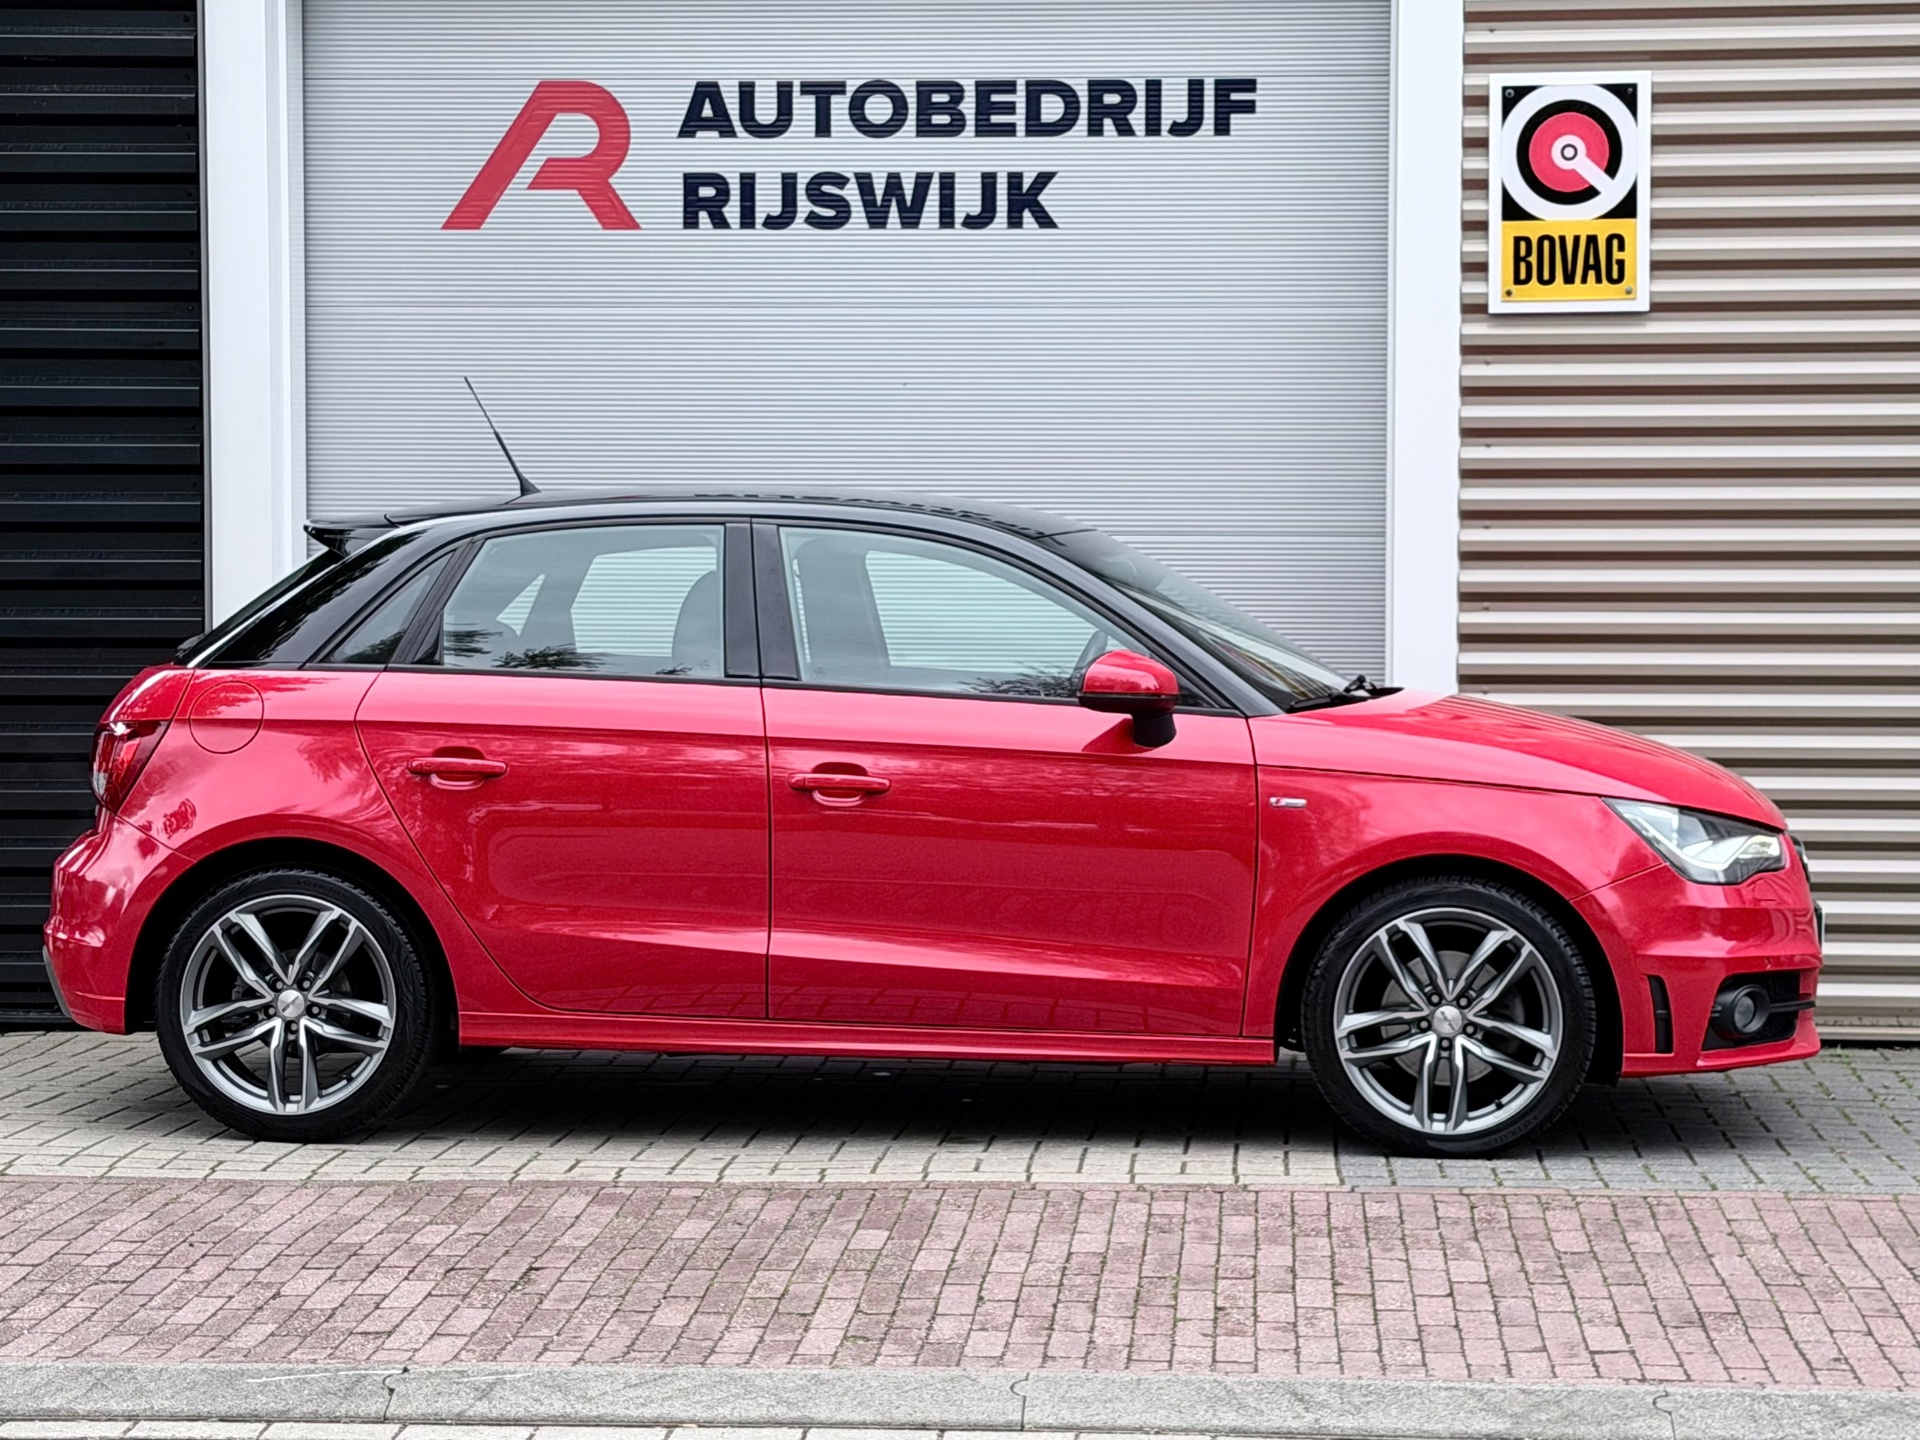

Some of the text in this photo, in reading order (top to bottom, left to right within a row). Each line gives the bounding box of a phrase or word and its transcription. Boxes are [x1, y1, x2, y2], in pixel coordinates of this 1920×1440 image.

[677, 78, 1258, 138] AUTOBEDRIJF
[681, 171, 1059, 231] RIJSWIJK
[1513, 233, 1626, 286] BOVAG
